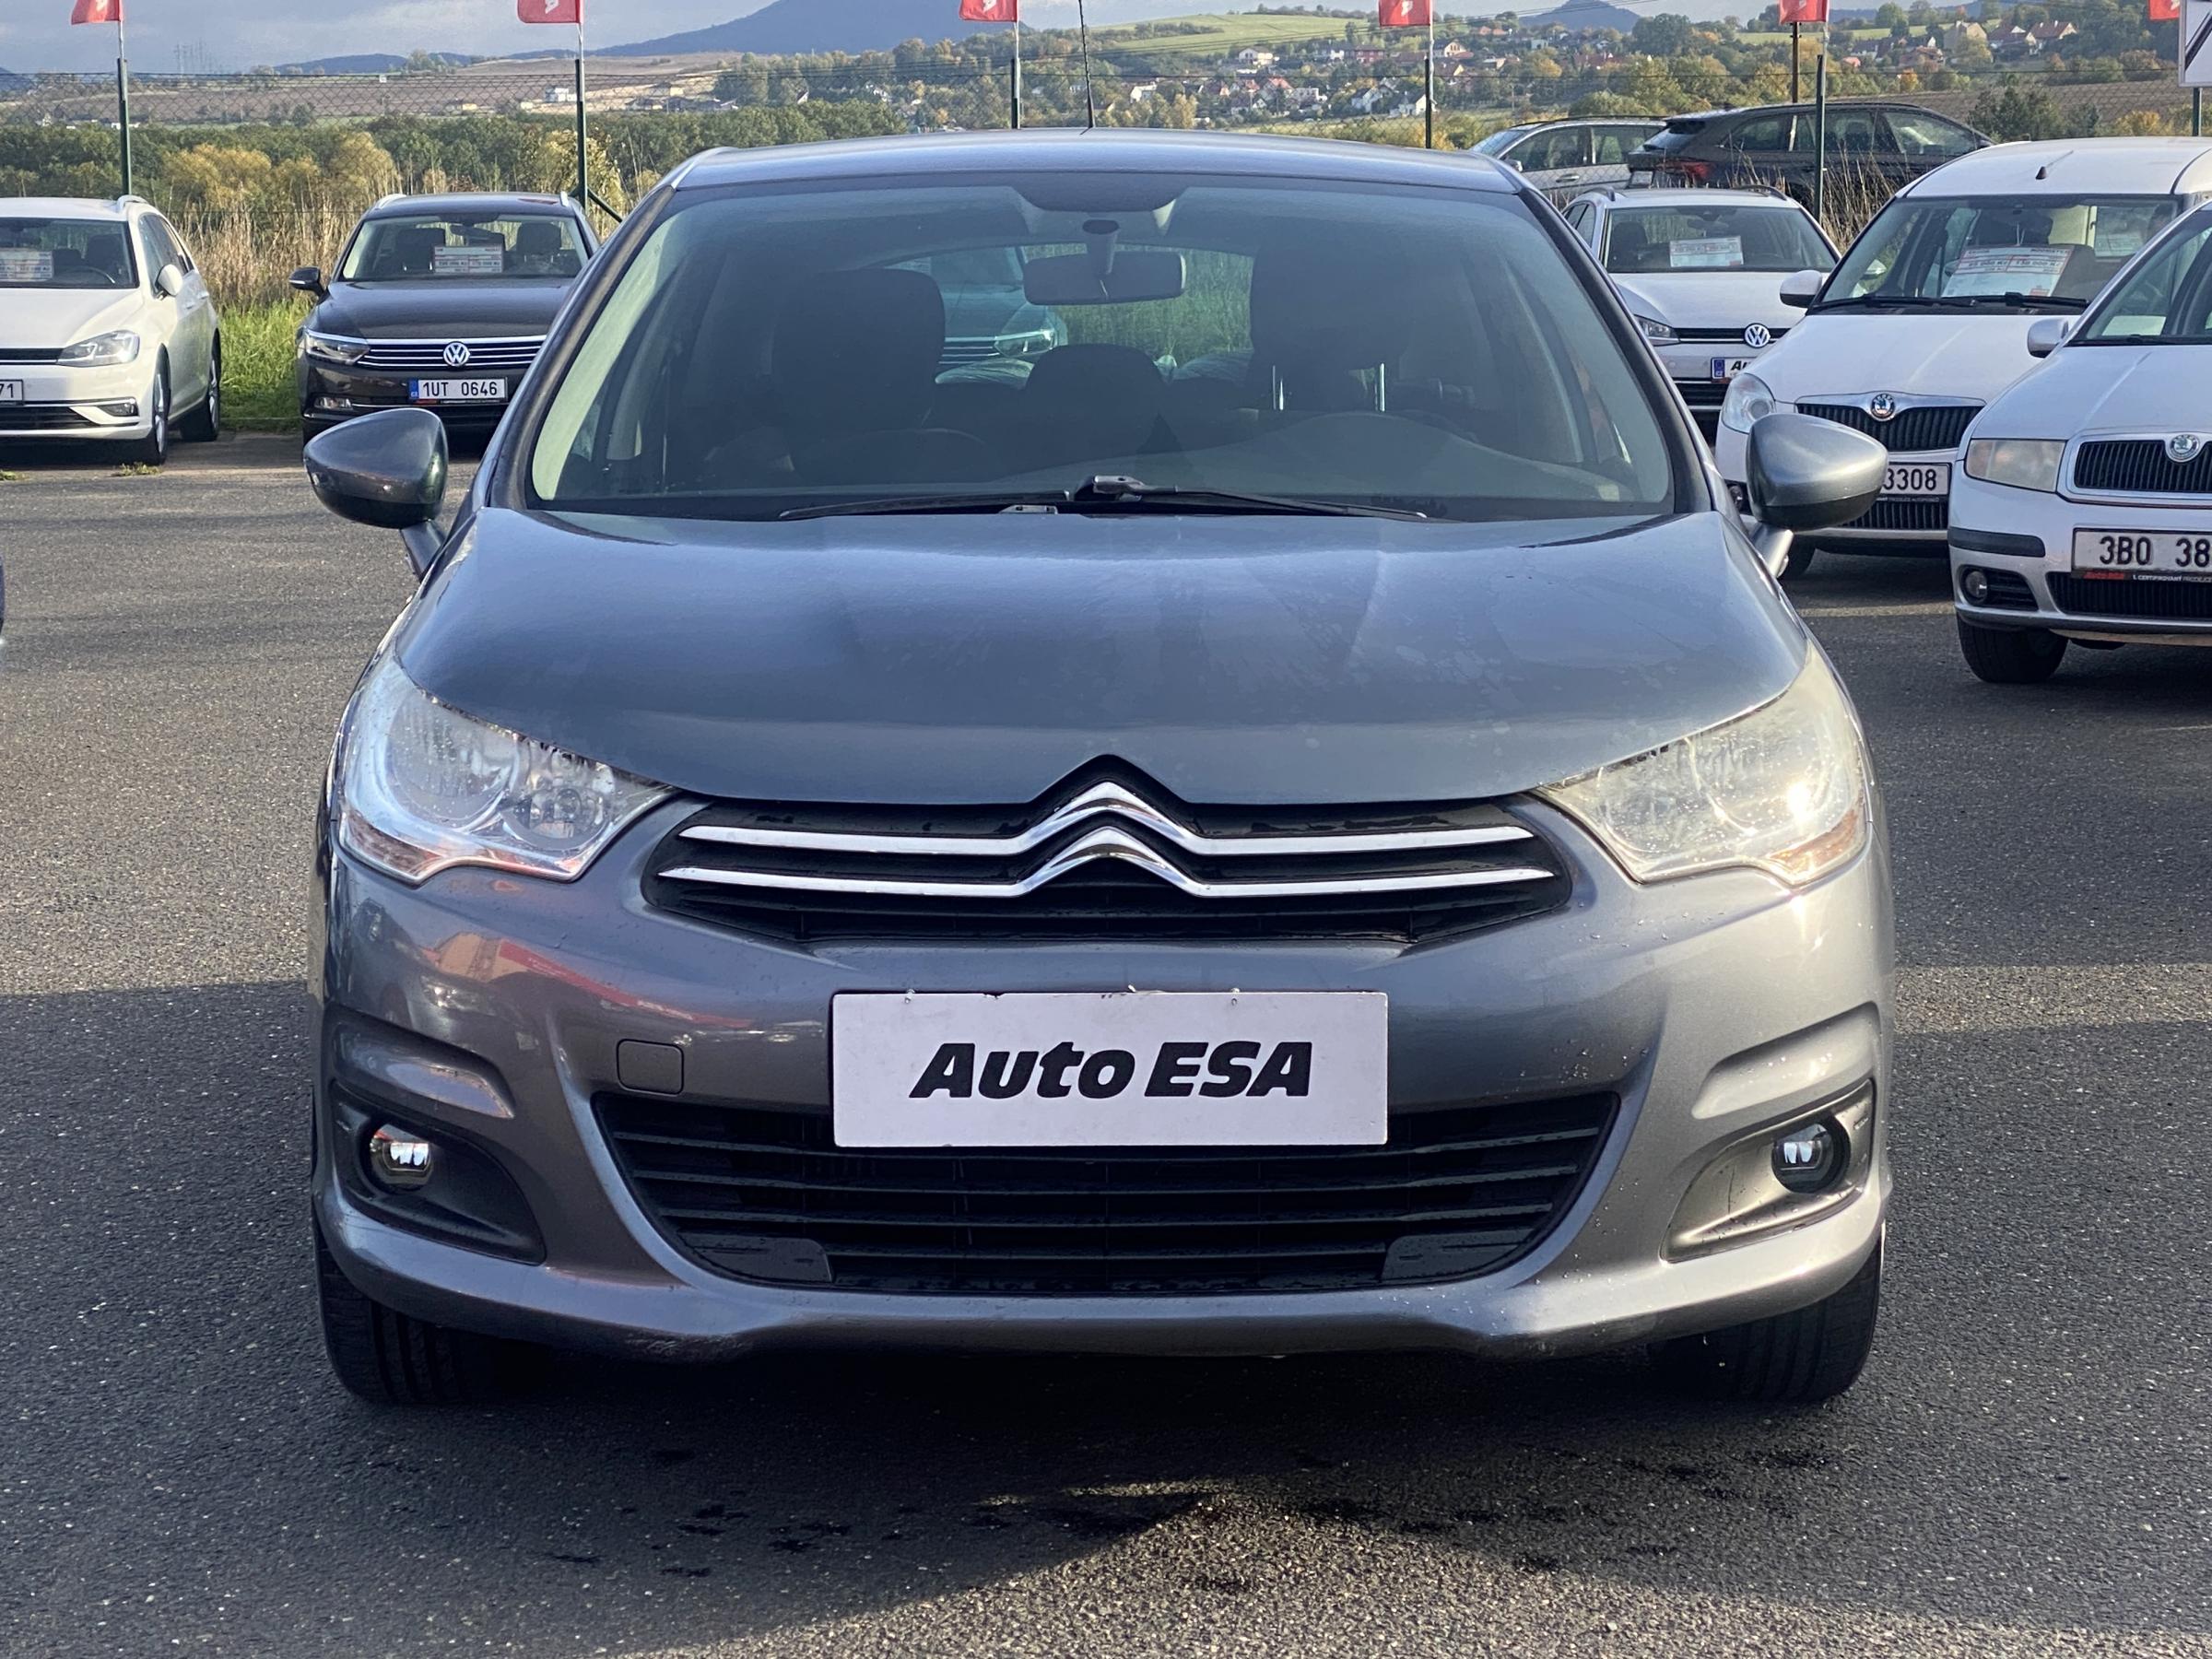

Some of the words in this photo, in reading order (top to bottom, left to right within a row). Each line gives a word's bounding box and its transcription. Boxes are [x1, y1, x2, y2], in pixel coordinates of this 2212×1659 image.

[423, 382, 449, 396] 1UT
[462, 381, 498, 396] 0646
[2100, 535, 2152, 565] 3B0
[2175, 538, 2210, 567] 38
[909, 1041, 1135, 1099] Auto
[1144, 1041, 1312, 1097] ESA
